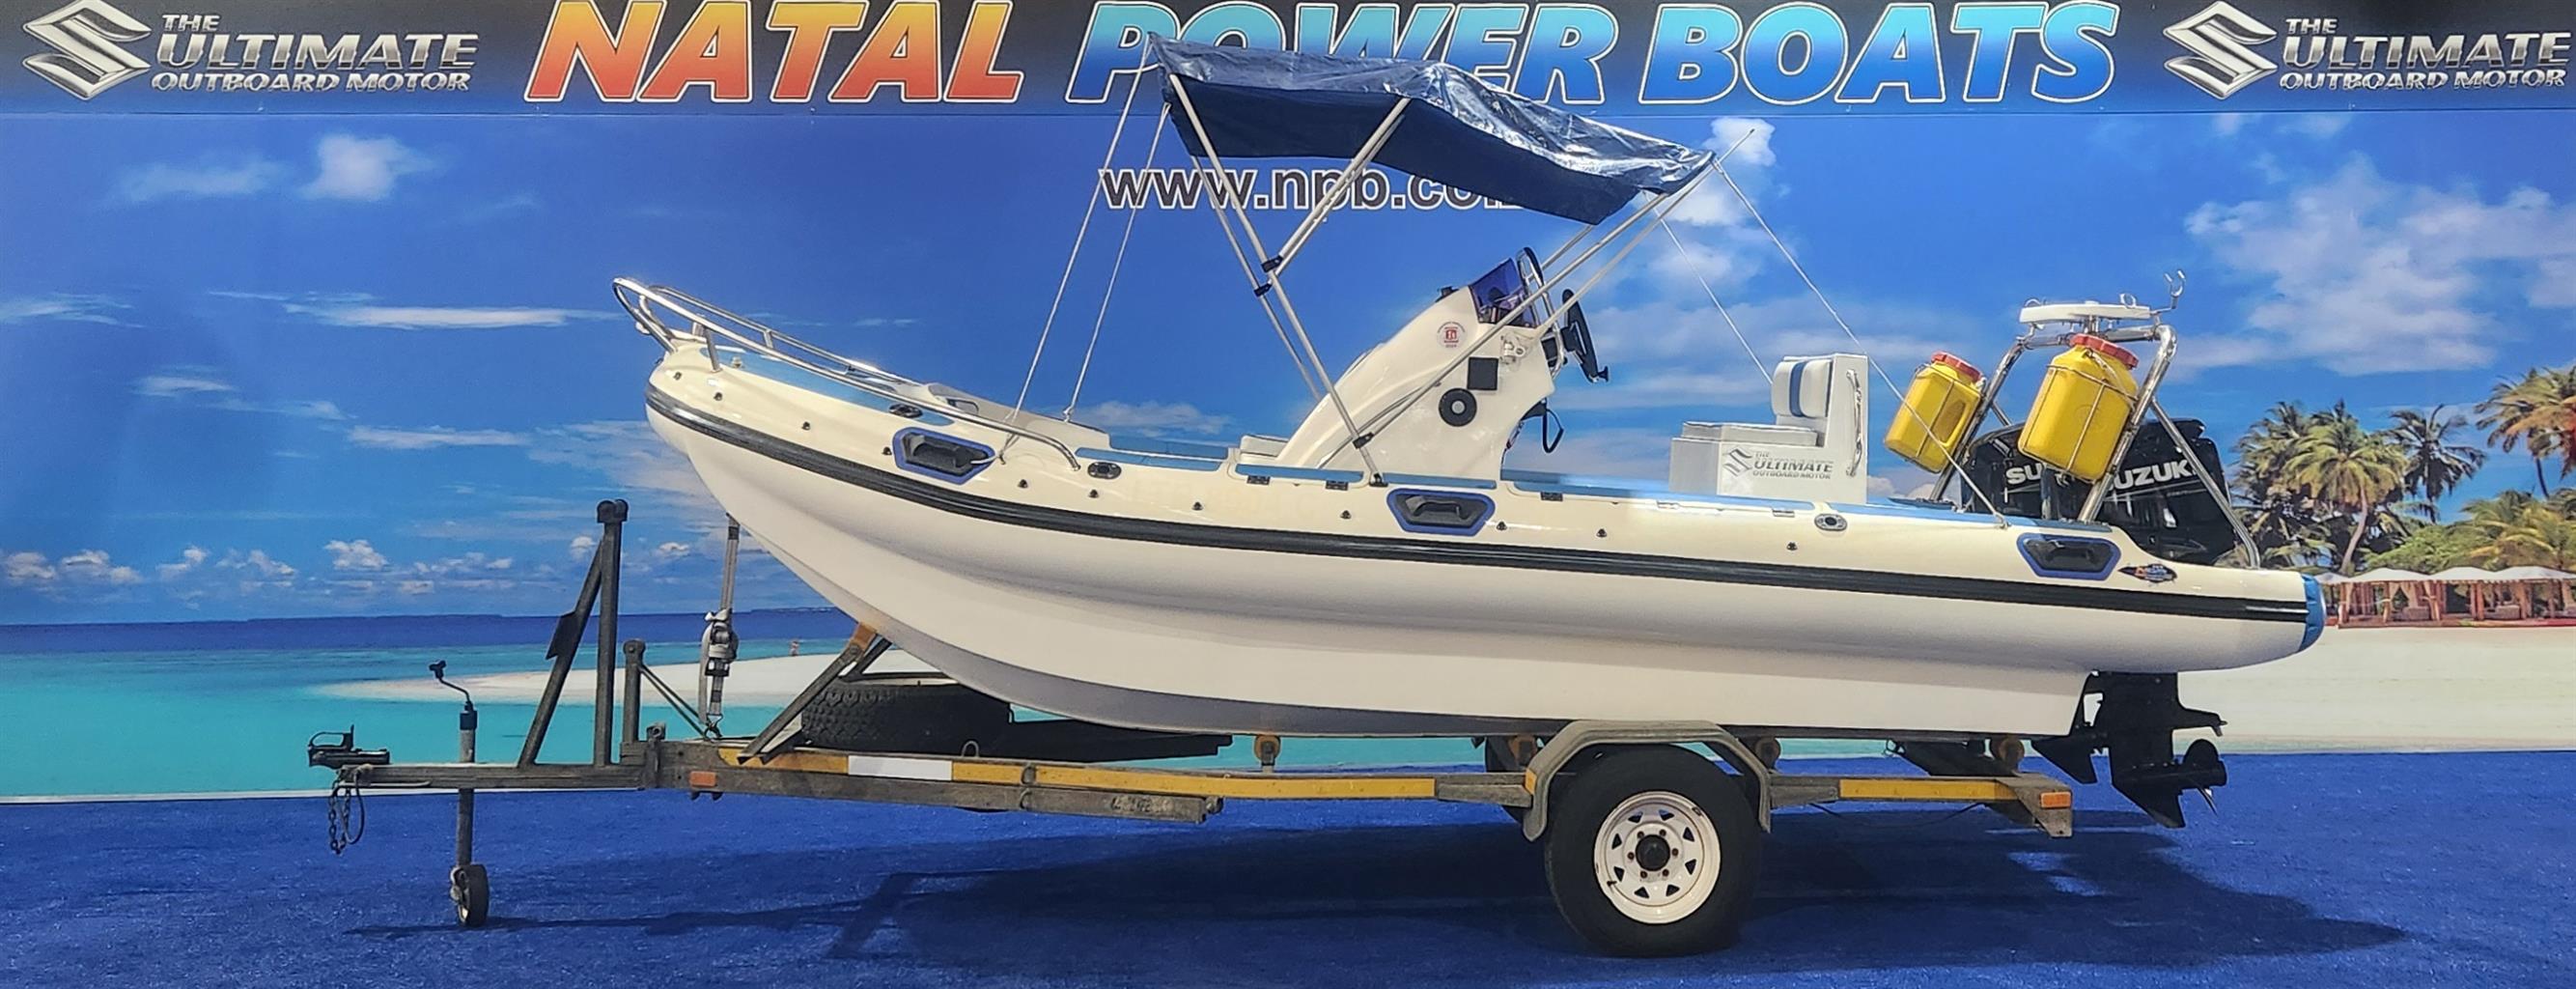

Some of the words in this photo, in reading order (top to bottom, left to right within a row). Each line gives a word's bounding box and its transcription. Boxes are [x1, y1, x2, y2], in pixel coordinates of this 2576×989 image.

[161, 14, 220, 32] THE
[2285, 17, 2338, 35] THE
[156, 33, 479, 71] ULTIMATE
[524, 0, 1023, 102] NATAL
[1638, 1, 2120, 104] BOATS
[2282, 32, 2572, 71] ULTIMATE
[151, 72, 341, 92] OUTBOARD
[345, 72, 471, 92] MOTOR
[2280, 71, 2450, 91] OUTBOARD
[2453, 69, 2567, 89] MOTOR
[1753, 458, 1834, 472] ULTIMATE
[2109, 459, 2199, 492] UZUK
